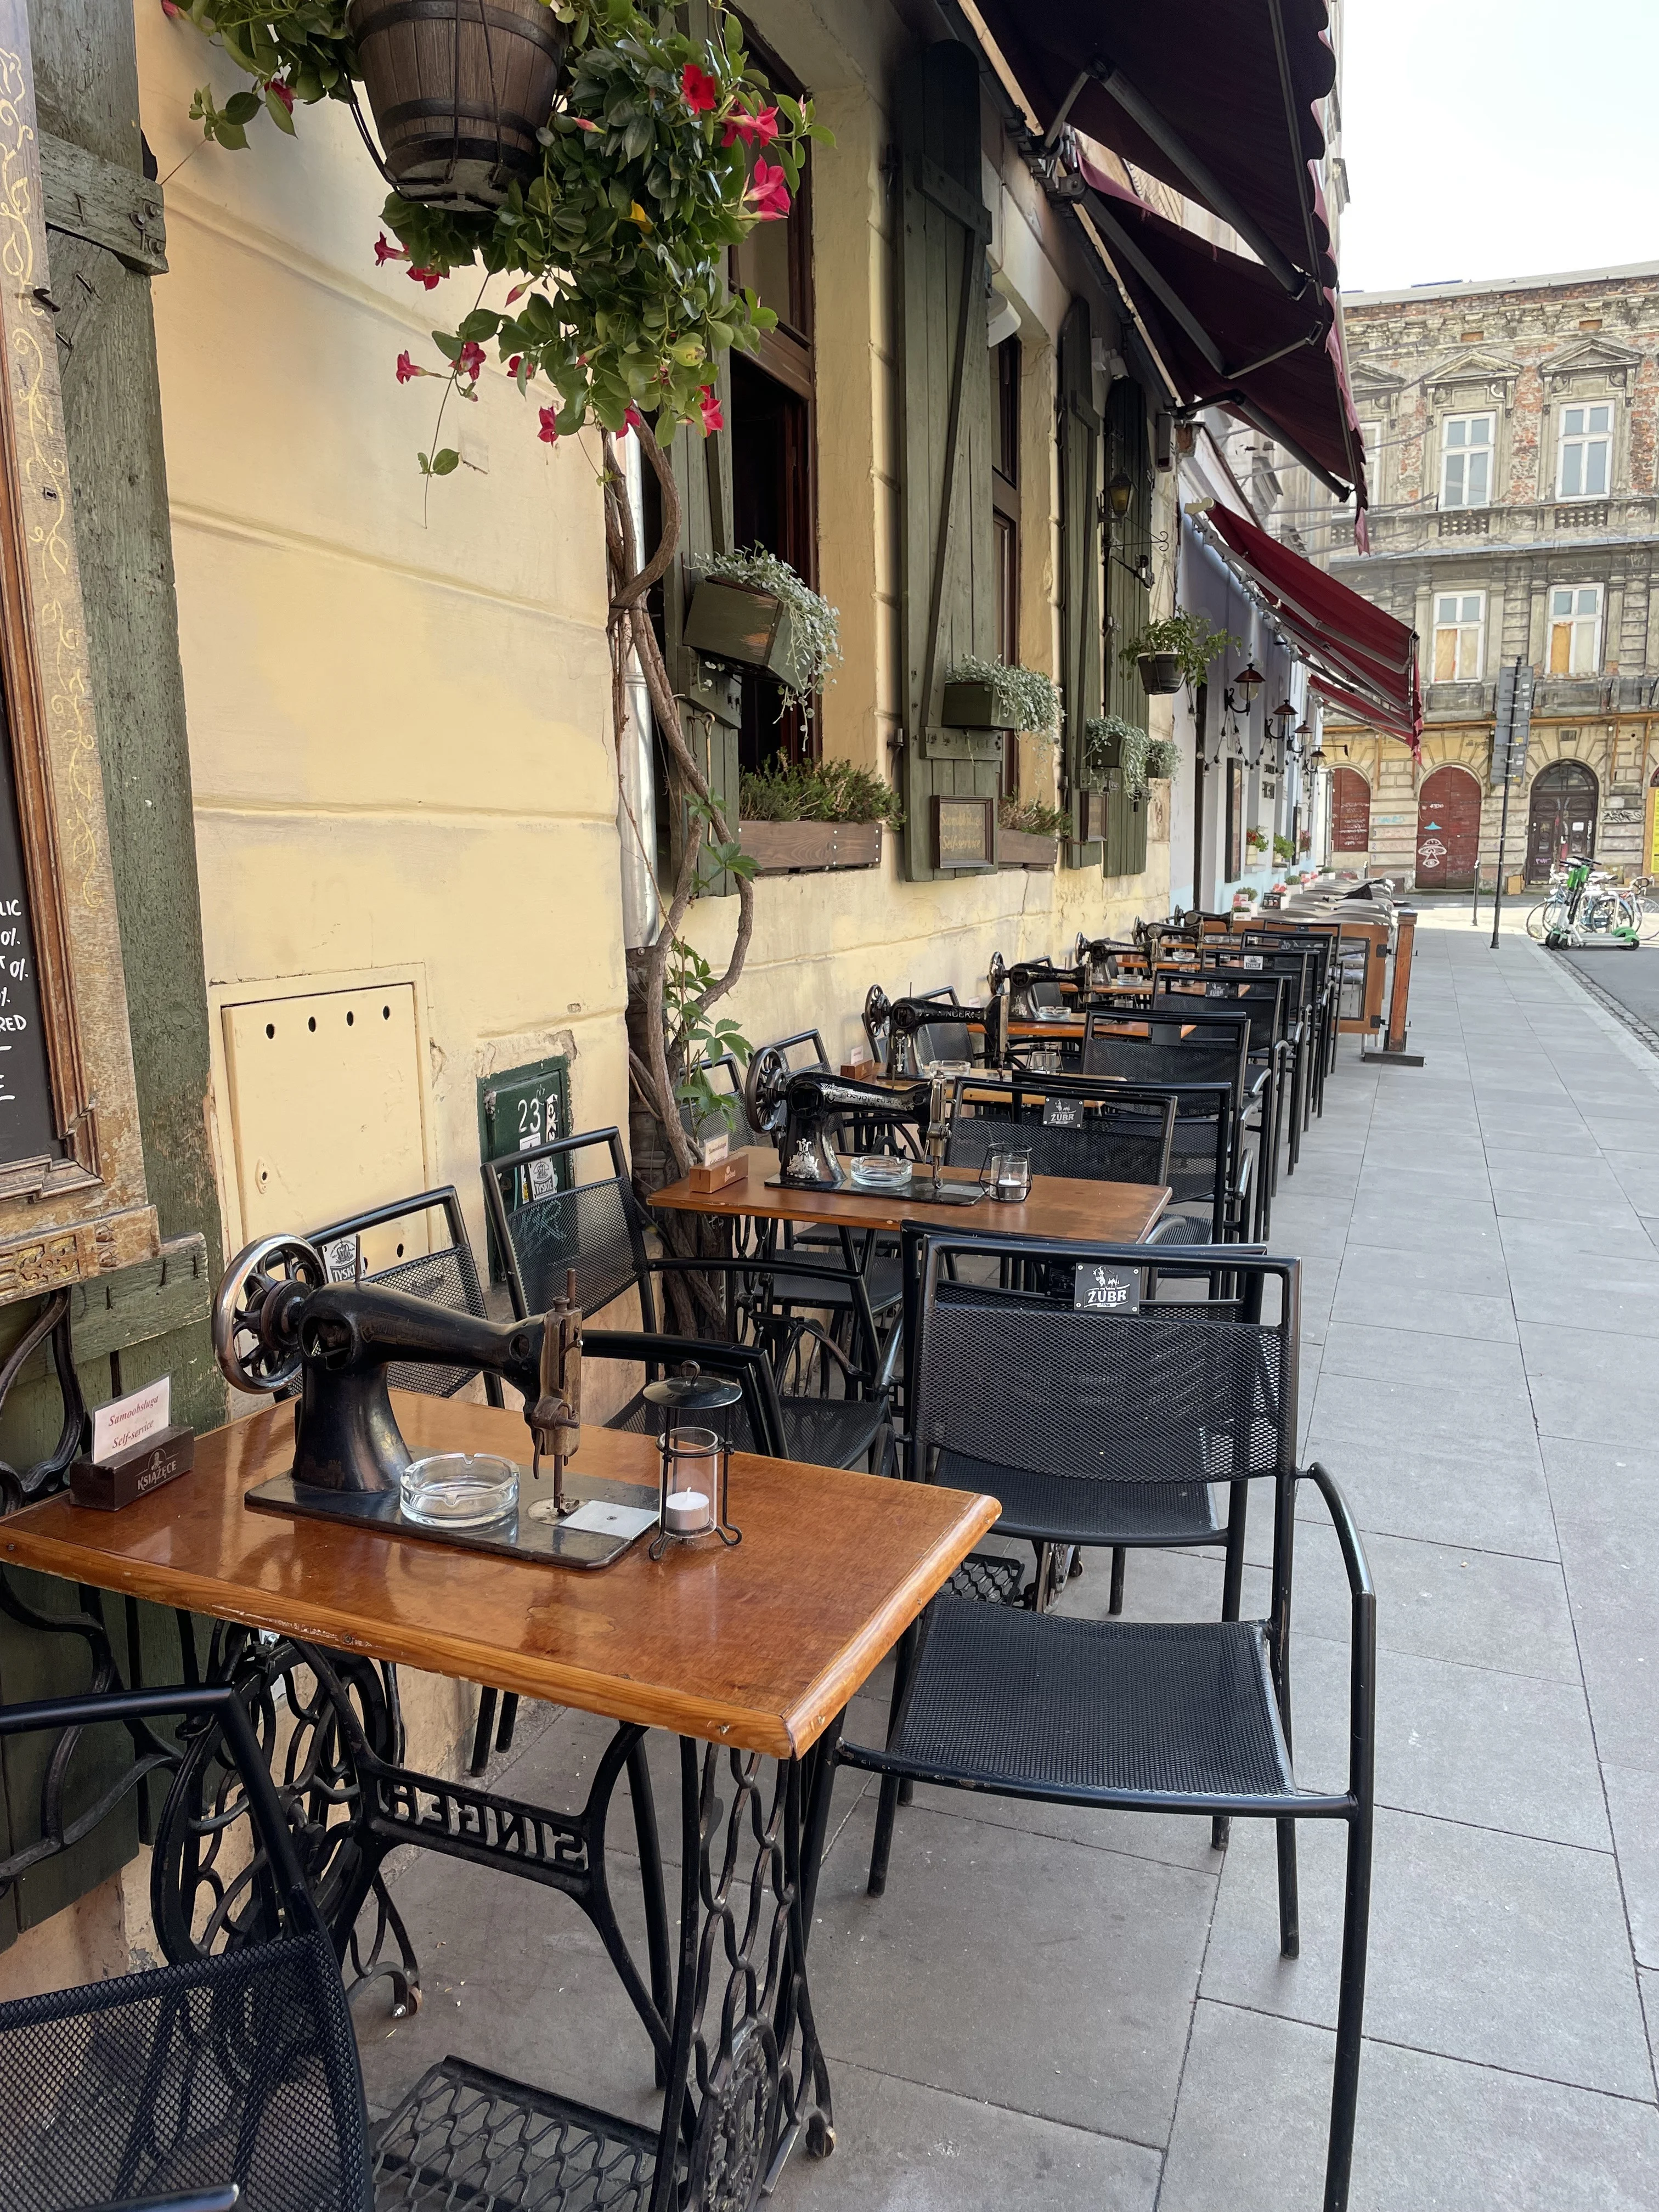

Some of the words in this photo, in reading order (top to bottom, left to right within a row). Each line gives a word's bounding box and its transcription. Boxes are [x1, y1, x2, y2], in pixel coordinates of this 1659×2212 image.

[517, 1098, 541, 1133] 23
[535, 1179, 553, 1195] TYSKIE
[332, 1263, 356, 1282] TYSKI
[112, 1420, 154, 1448] Self-service
[138, 1460, 177, 1491] KSIĄŻĘCE
